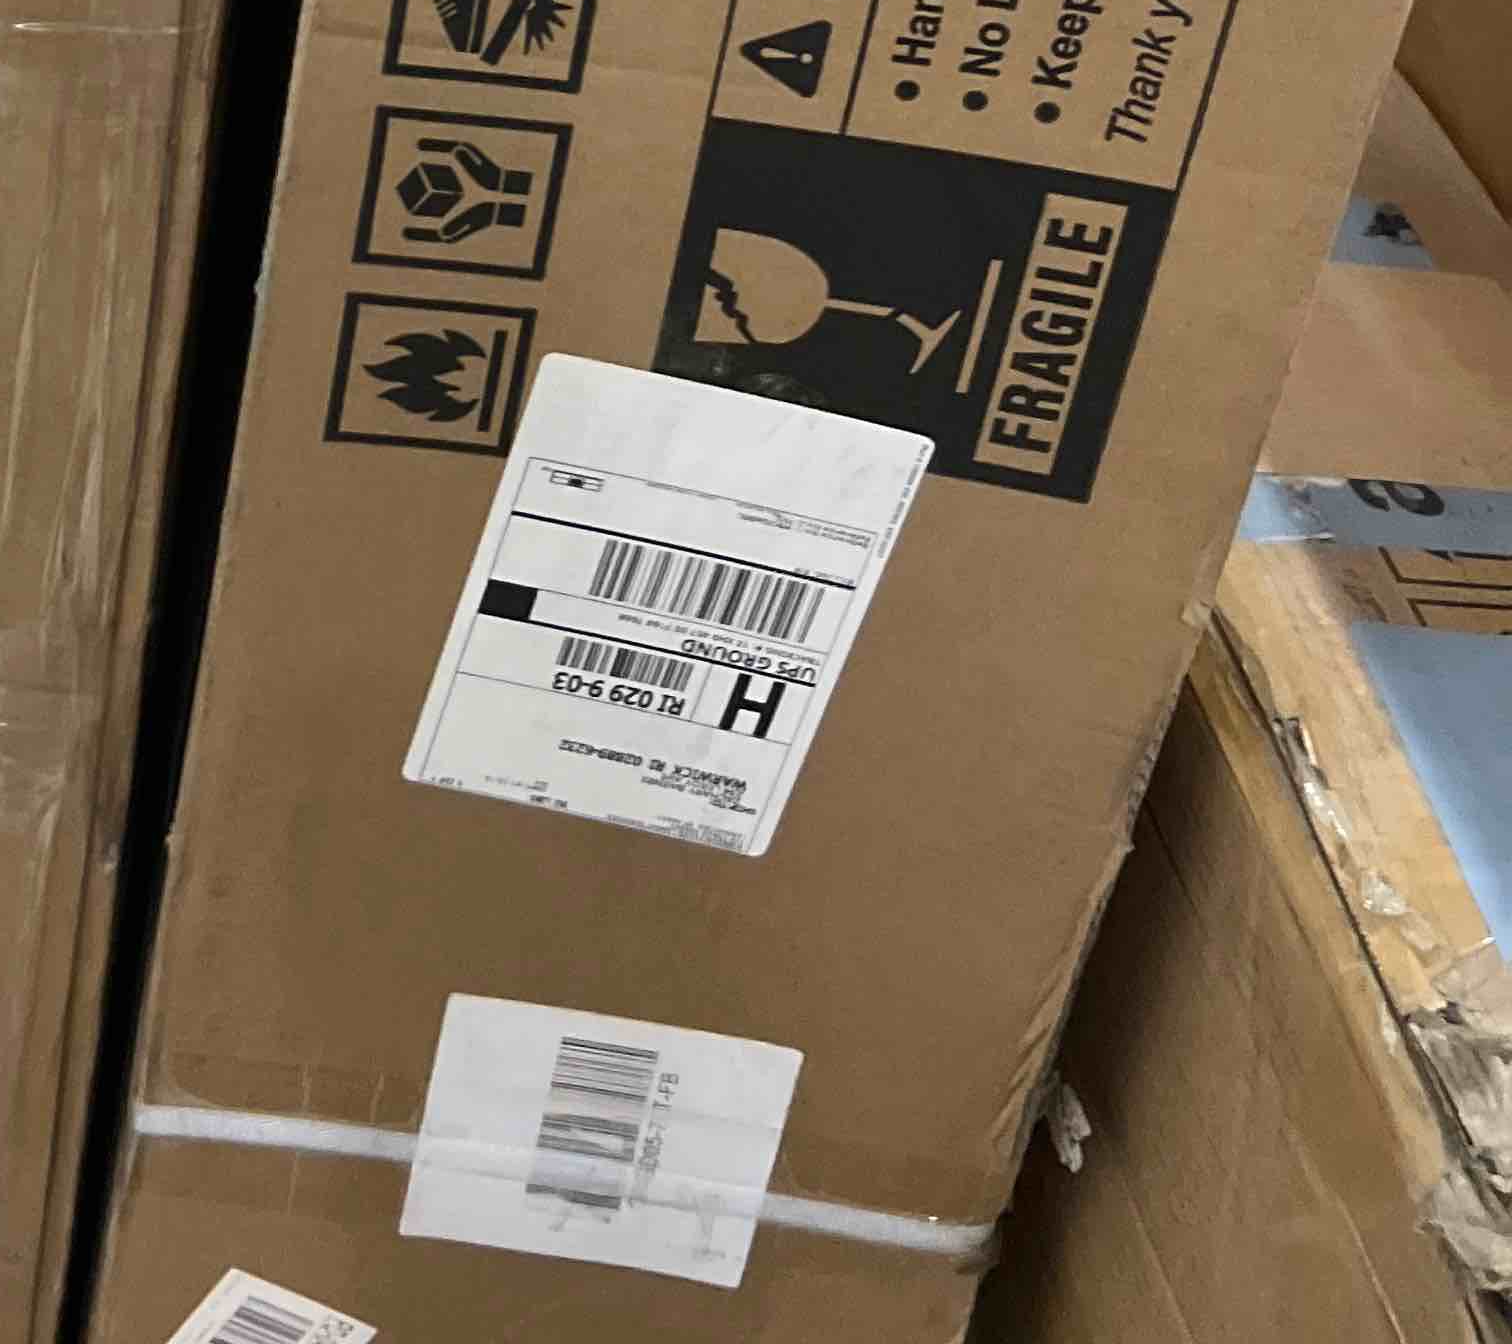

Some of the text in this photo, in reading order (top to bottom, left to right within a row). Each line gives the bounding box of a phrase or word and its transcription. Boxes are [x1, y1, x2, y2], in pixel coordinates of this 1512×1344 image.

[958, 21, 1011, 78] No
[1104, 28, 1177, 144] Thank
[988, 217, 1115, 454] FRAGILE
[681, 638, 817, 683] UPS GROUND
[551, 671, 787, 739] H RI 029 9-03
